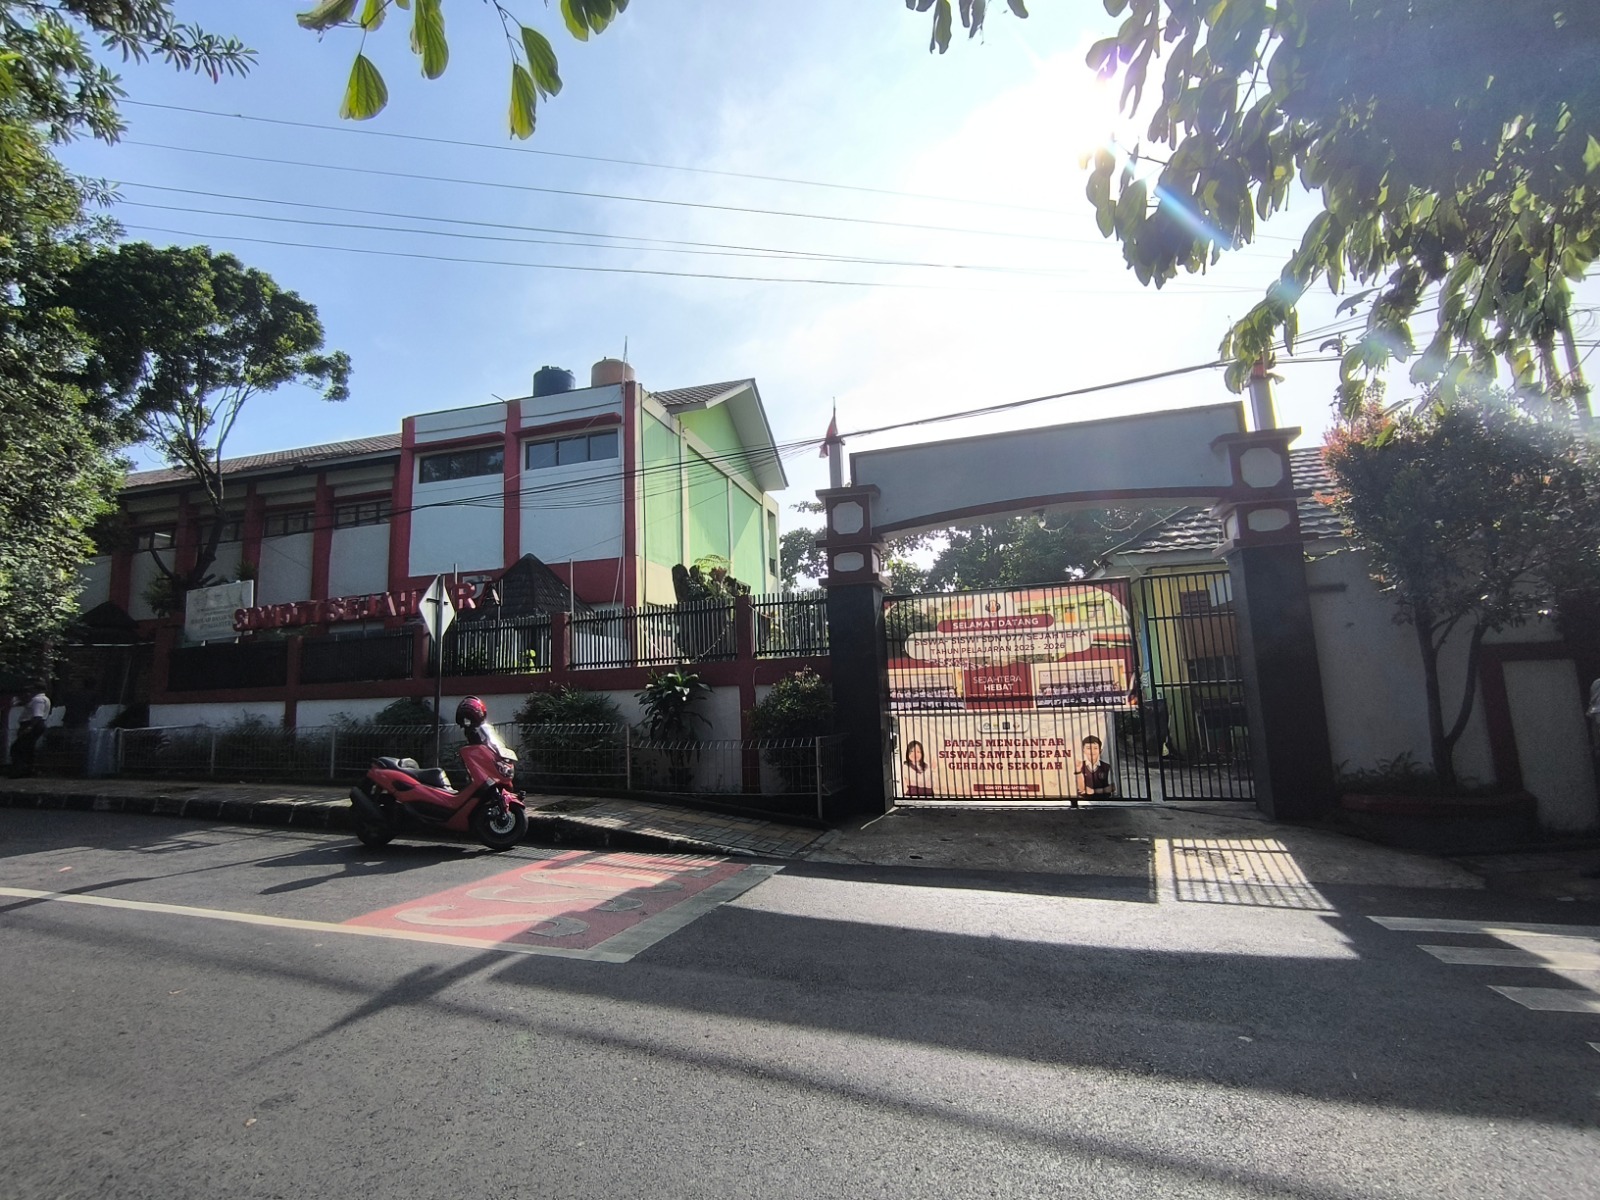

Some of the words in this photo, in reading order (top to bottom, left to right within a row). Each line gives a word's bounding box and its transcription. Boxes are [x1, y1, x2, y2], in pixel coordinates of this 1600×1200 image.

[953, 620, 995, 630] SELAMAT
[998, 617, 1039, 628] DATANG
[952, 636, 979, 644] SISWI
[982, 634, 1001, 643] SDN
[1005, 633, 1023, 642] 077
[1026, 631, 1086, 641] SEJAHTERA
[930, 647, 959, 655] TAHUN
[962, 645, 1011, 654] PELAJARAN
[1014, 643, 1035, 651] 2025
[1043, 642, 1066, 650] 2026
[972, 674, 1022, 684] SEJAHTERA
[984, 683, 1013, 691] HEBAT
[944, 739, 982, 748] BATAS
[985, 738, 1065, 747] MENGANTAR
[939, 750, 976, 759] SISWA
[979, 750, 1026, 759] SAMPAI
[1030, 749, 1072, 758] DEPAN
[948, 762, 1004, 771] GERBANG
[1008, 761, 1063, 770] SEKOLAH
